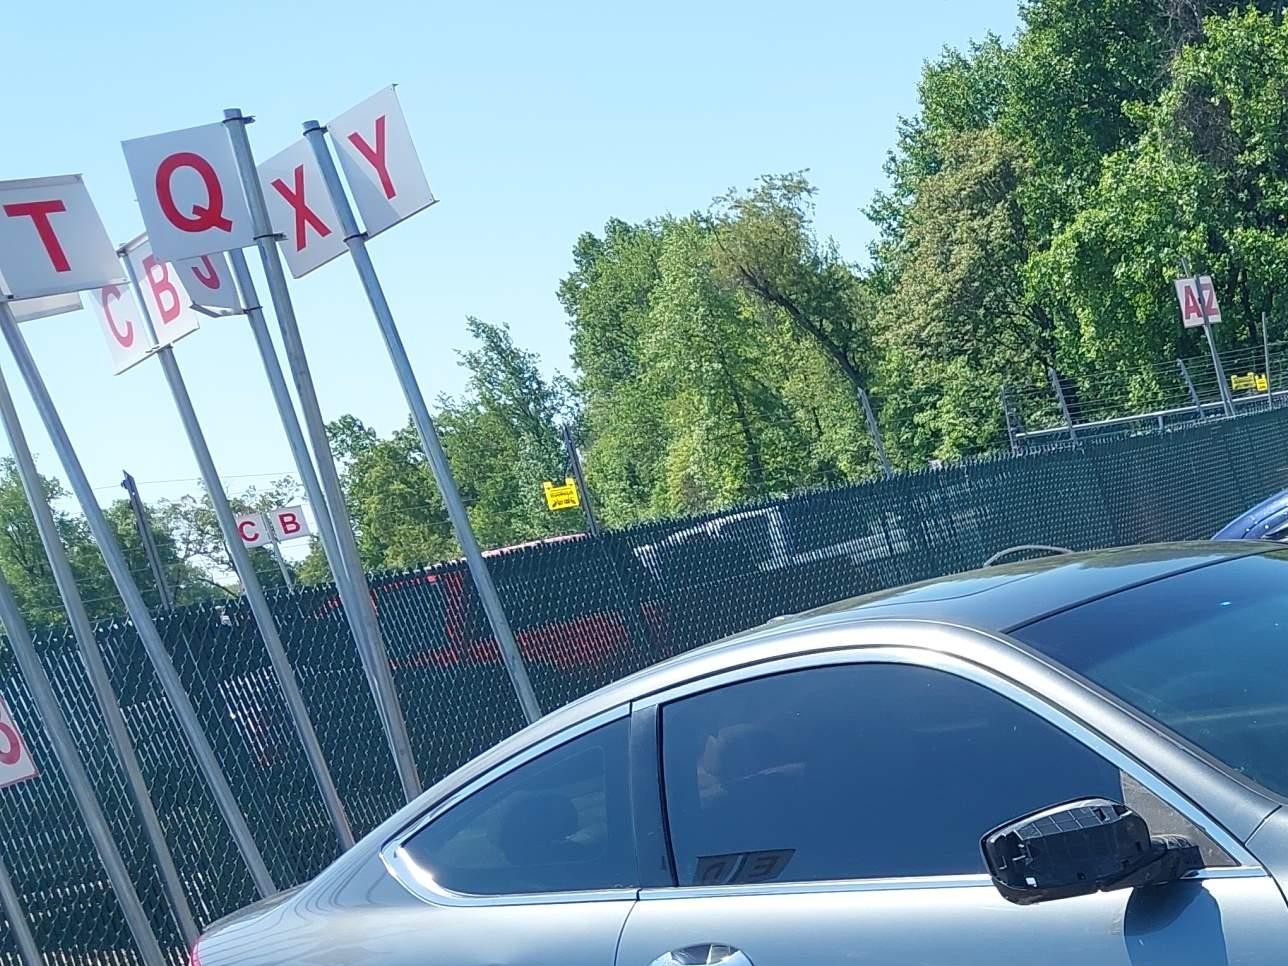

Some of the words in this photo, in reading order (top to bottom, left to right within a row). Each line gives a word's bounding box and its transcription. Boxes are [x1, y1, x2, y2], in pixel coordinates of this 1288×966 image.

[155, 152, 233, 234] Q
[347, 114, 397, 201] Y
[3, 199, 72, 273] T
[270, 164, 332, 252] X
[101, 285, 134, 348] C
[142, 254, 181, 325] B
[238, 520, 259, 542] C
[278, 512, 301, 535] B
